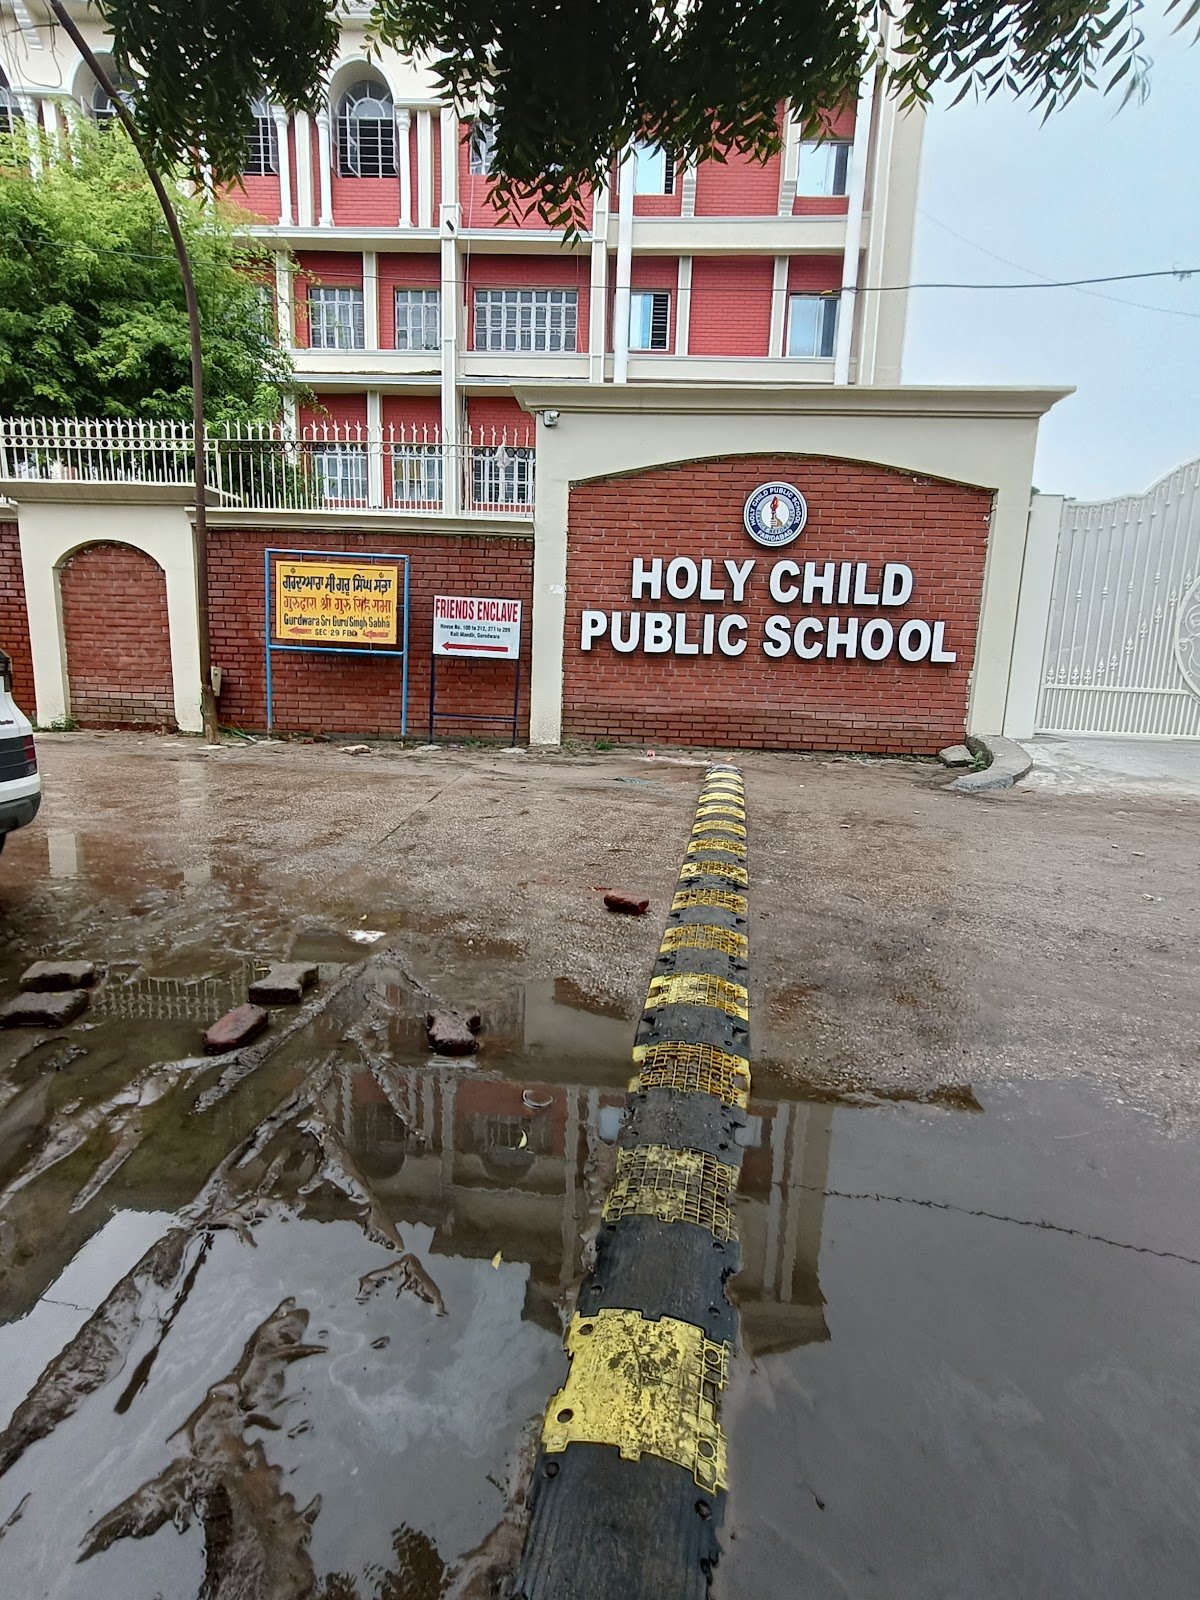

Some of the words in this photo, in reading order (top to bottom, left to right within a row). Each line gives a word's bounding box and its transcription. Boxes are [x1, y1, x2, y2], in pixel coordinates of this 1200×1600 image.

[751, 489, 769, 507] CHILD
[769, 487, 794, 499] PUBLIC
[792, 497, 801, 525] SCHOOL
[756, 529, 793, 542] FARIDABAD
[631, 556, 756, 602] HOLY
[769, 559, 914, 606] CHILD
[320, 594, 332, 610] श्री
[435, 598, 475, 620] FRIENDS
[477, 601, 518, 623] ENCLAVE
[283, 613, 320, 626] Gurdwara
[320, 615, 331, 626] Sri
[332, 615, 349, 627] Guru
[349, 615, 368, 630] Singh
[368, 617, 391, 628] Sabha
[581, 610, 748, 656] PUBLIC
[762, 614, 957, 663] SCHOOL
